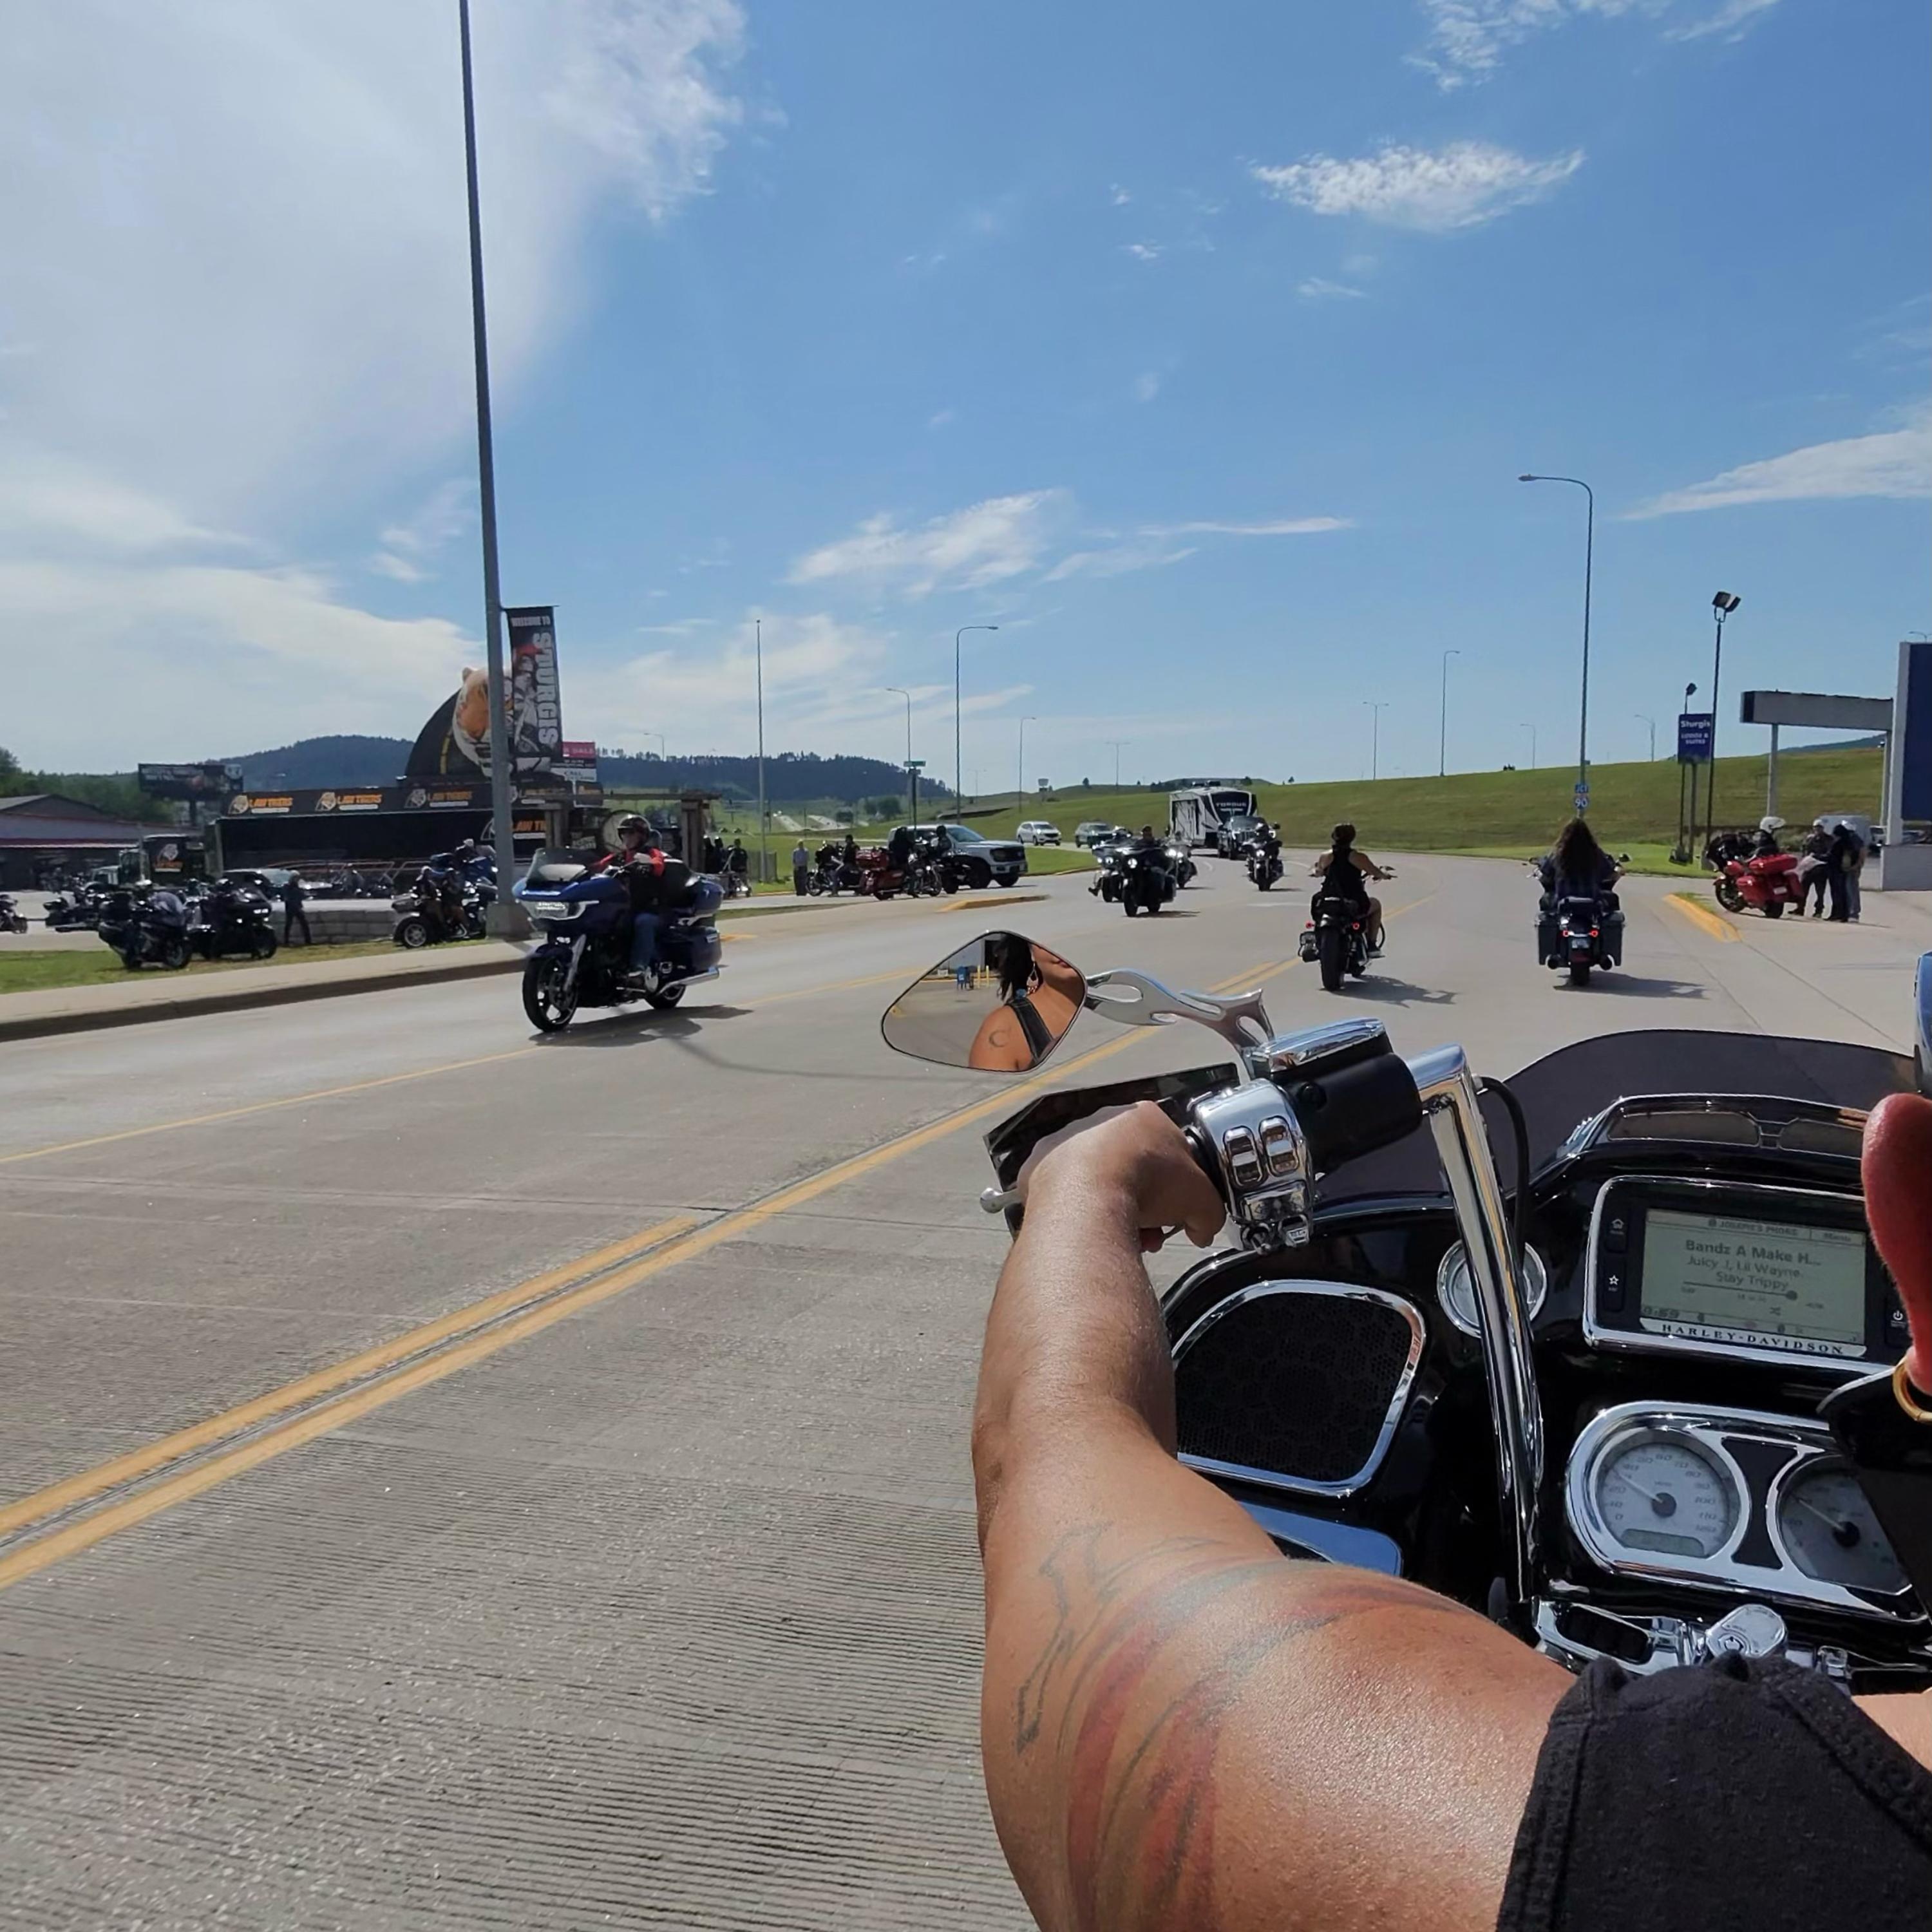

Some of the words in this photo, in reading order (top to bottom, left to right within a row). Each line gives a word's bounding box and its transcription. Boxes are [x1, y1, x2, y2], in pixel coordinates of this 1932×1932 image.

[511, 616, 541, 627] WELCOME
[542, 616, 551, 625] TO
[532, 632, 559, 745] STURGIS
[1680, 719, 1710, 729] Sturgis
[428, 792, 445, 801] LAW
[446, 791, 473, 800] TIGERS
[1575, 798, 1587, 808] 90
[1686, 1240, 1731, 1255] Bandz
[1736, 1245, 1747, 1256] A
[1752, 1247, 1793, 1262] Make
[1687, 1256, 1719, 1270] Juicy
[1737, 1260, 1750, 1272] Lil
[1716, 1271, 1744, 1286] Stay
[1748, 1275, 1790, 1292] Trippy
[1662, 1323, 1844, 1356] HARLEY-DAVIDSON
